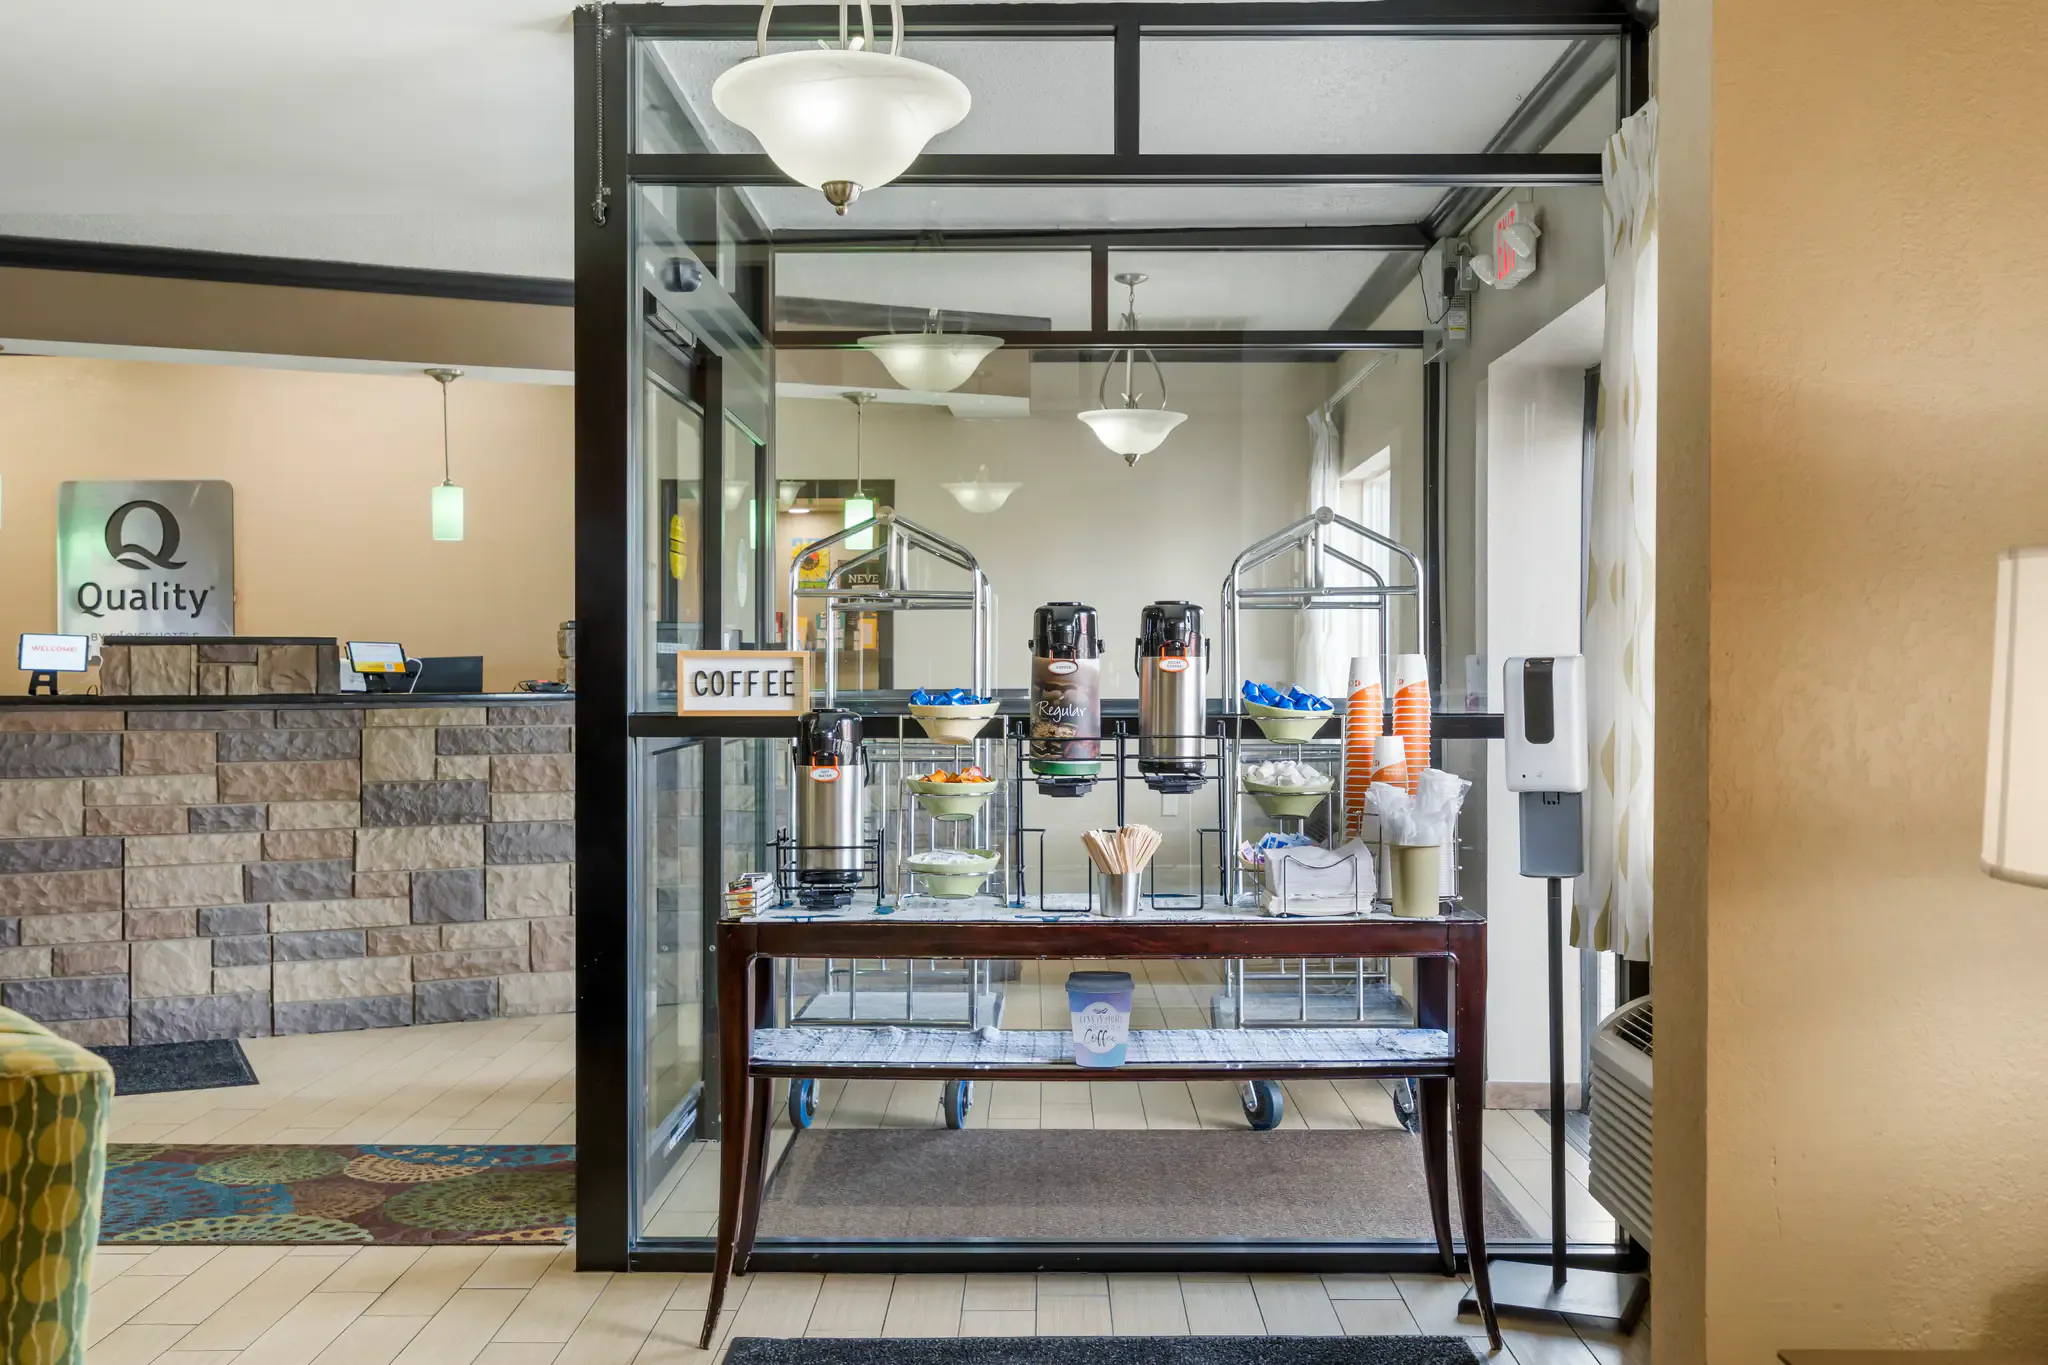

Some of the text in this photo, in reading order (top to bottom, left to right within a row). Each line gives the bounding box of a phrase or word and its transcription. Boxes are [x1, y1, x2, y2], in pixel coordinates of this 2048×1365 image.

[104, 499, 188, 570] Q
[77, 581, 209, 618] Quality
[693, 669, 796, 697] COFFEE
[1035, 700, 1087, 723] Regular
[1083, 1028, 1117, 1047] Coffee
